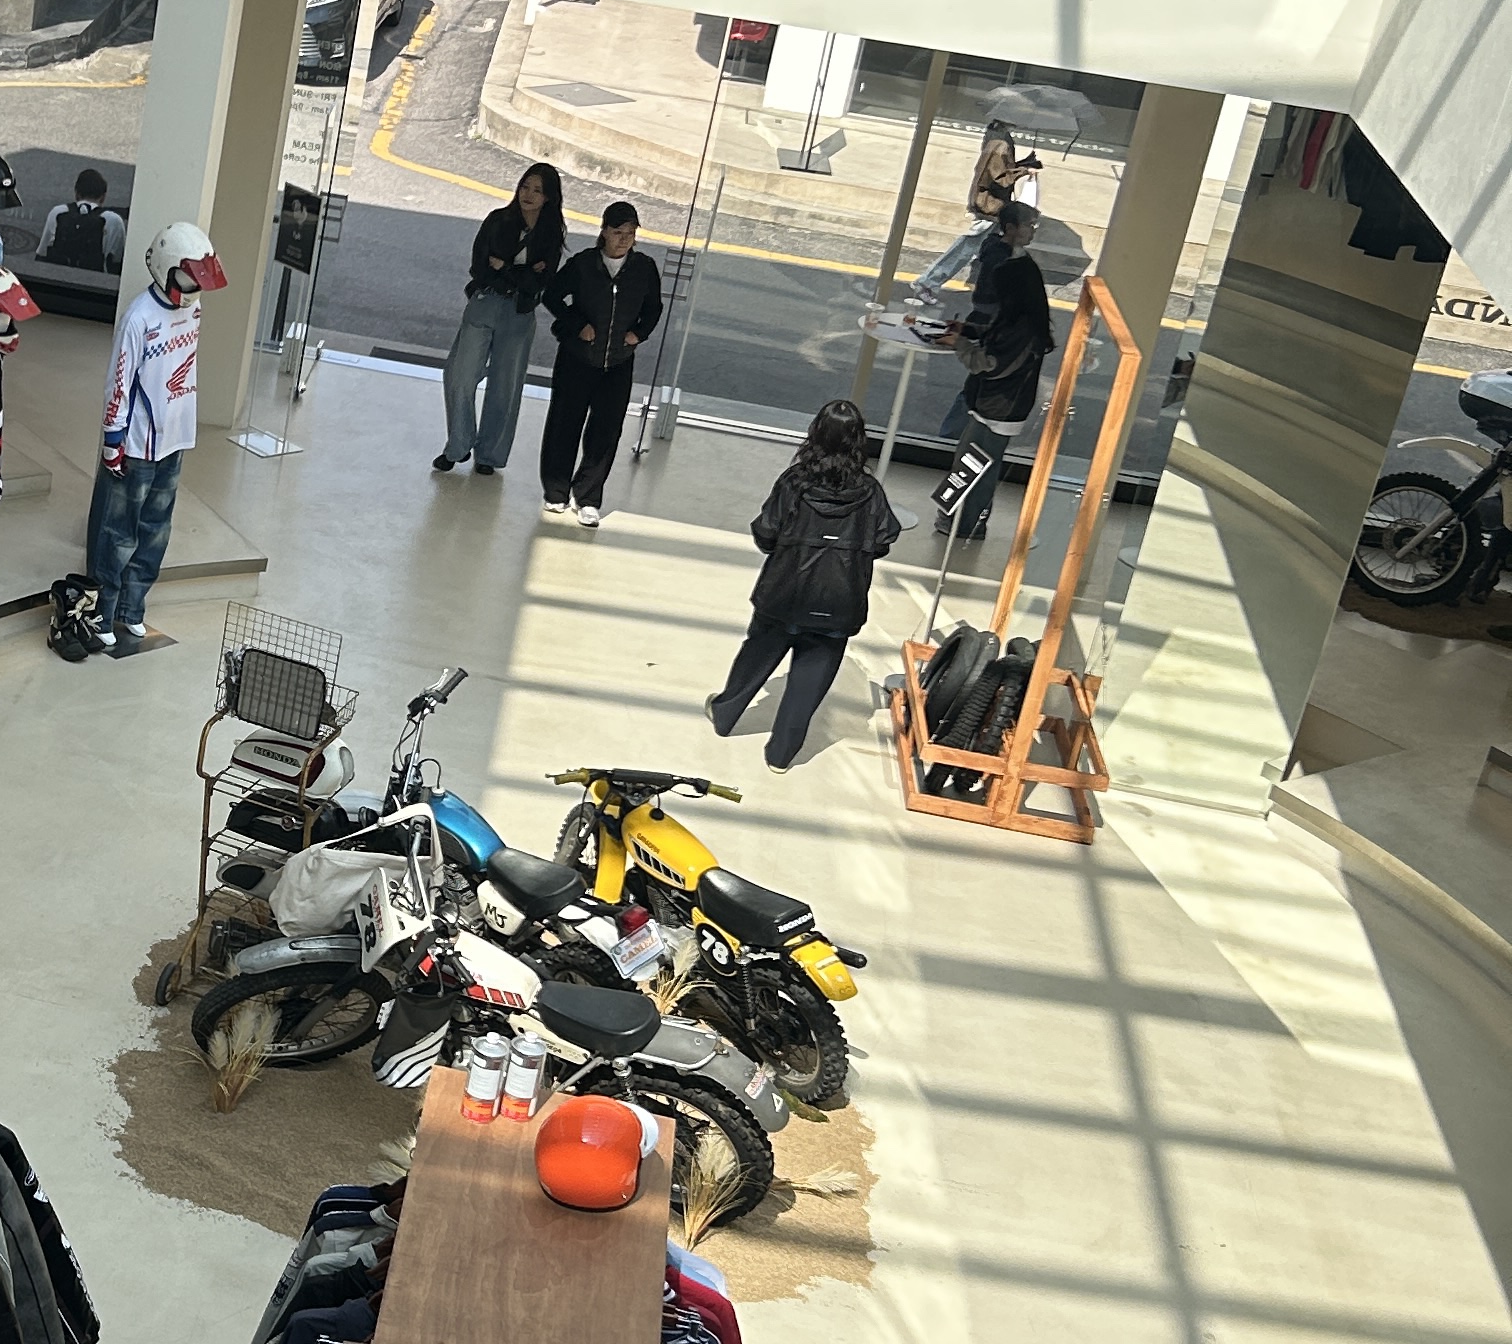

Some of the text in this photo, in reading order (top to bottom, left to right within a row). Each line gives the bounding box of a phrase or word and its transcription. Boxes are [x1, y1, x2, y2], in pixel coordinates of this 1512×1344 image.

[254, 745, 303, 768] HONDA
[776, 912, 813, 934] HONDA
[620, 935, 658, 964] CAMEL
[700, 929, 728, 966] 78
